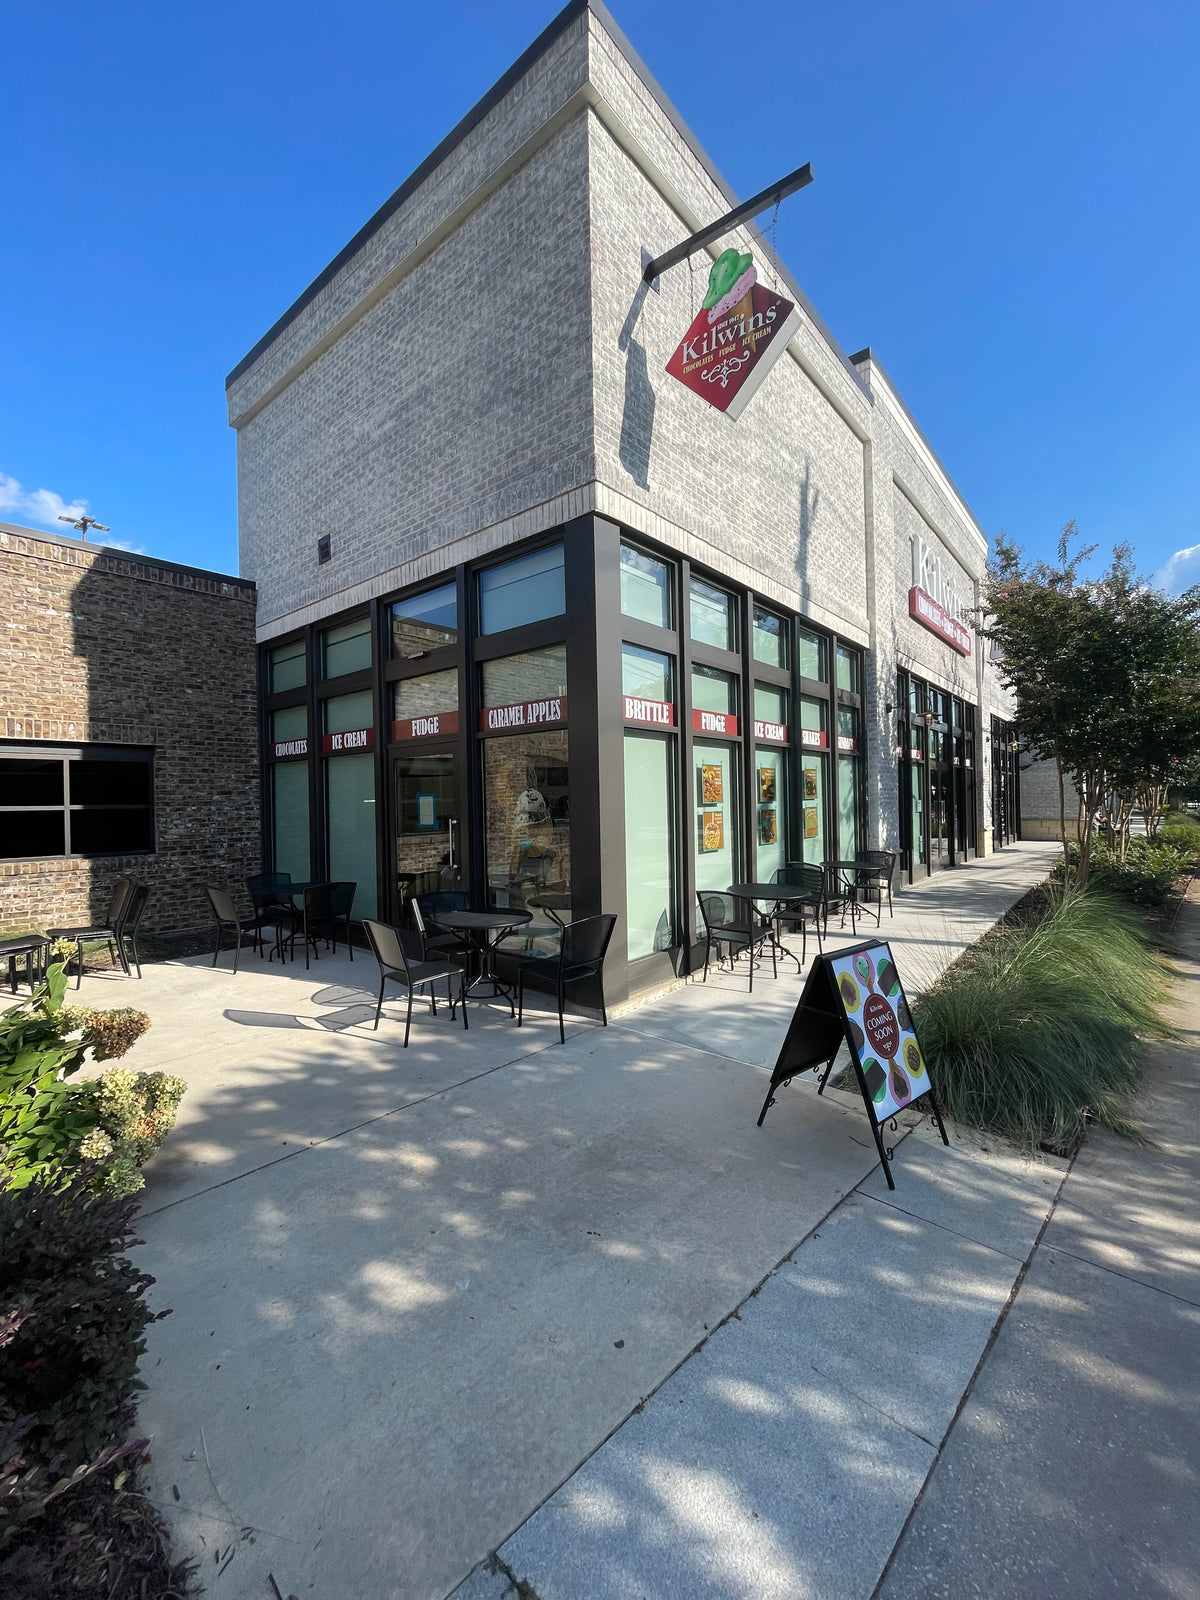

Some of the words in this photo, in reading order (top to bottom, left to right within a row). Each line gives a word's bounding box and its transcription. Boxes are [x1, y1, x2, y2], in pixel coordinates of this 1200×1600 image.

[681, 304, 778, 366] Kilwins
[683, 354, 714, 375] CHOCOLATES
[719, 343, 737, 357] FUDGE
[742, 336, 752, 346] ICE
[752, 326, 772, 341] CREAM
[488, 705, 525, 729] CARAMEL
[527, 699, 561, 724] APPLES
[625, 698, 670, 724] BRITTLE
[411, 716, 440, 737] FUDGE
[701, 712, 726, 733] FUDGE
[754, 721, 764, 738] ICE
[764, 723, 784, 741] CREAM
[275, 739, 308, 757] CHOCOLATES
[331, 735, 343, 750] ICE
[344, 730, 367, 748] CREAM
[867, 1010, 893, 1030] COMING
[874, 1025, 894, 1041] SOON
